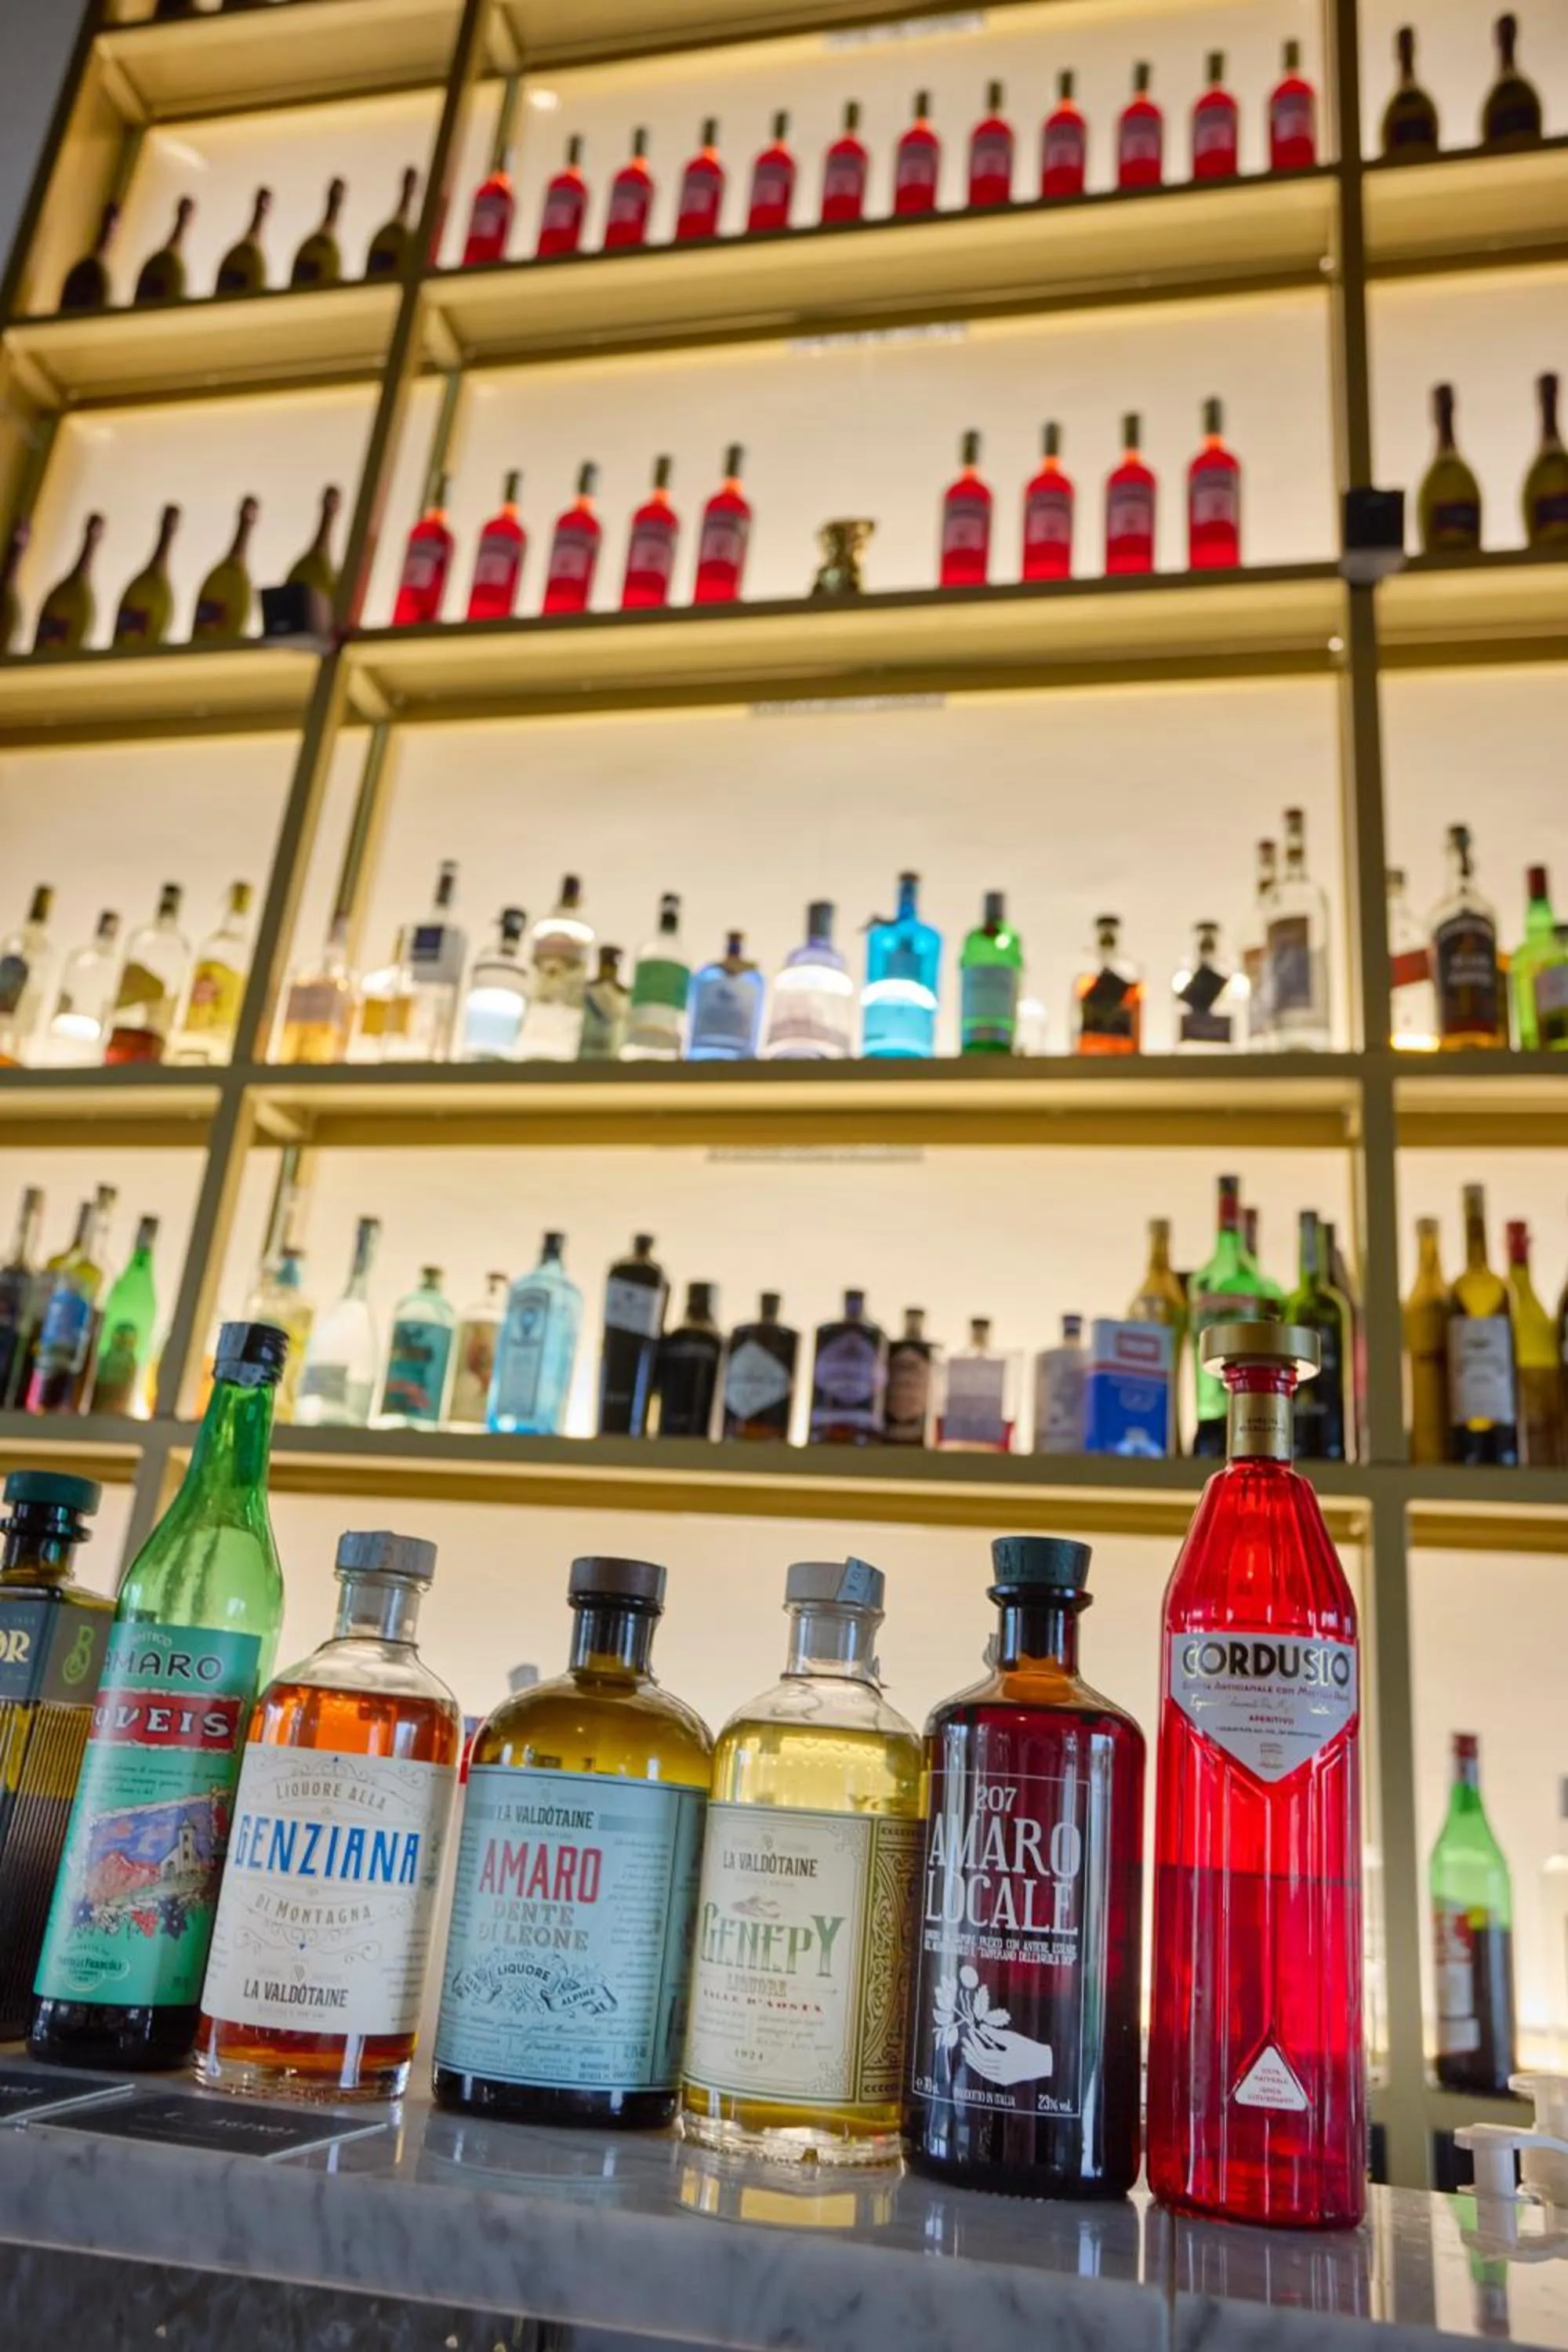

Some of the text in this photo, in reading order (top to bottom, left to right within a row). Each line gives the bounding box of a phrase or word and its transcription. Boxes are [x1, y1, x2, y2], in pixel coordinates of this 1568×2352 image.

[1183, 1641, 1350, 1686] CORDUSIO
[276, 1780, 387, 1813] LIQUORE ALLA
[978, 1784, 1017, 1813] 207
[496, 1804, 594, 1830] LA VALDÔTAINE
[235, 1814, 422, 1884] GENZIANA
[928, 1811, 1082, 1878] AMARO
[477, 1838, 603, 1904] AMARO
[722, 1849, 818, 1878] LA VALDÔTAINE
[276, 1900, 372, 1926] MONTAGNA
[492, 1897, 575, 1927] DENTE
[924, 1870, 1079, 1936] LOCALE
[503, 1923, 590, 1952] LEONE
[496, 1962, 552, 1982] LIQUORE
[243, 1978, 349, 2008] LA VALDÔTAINE
